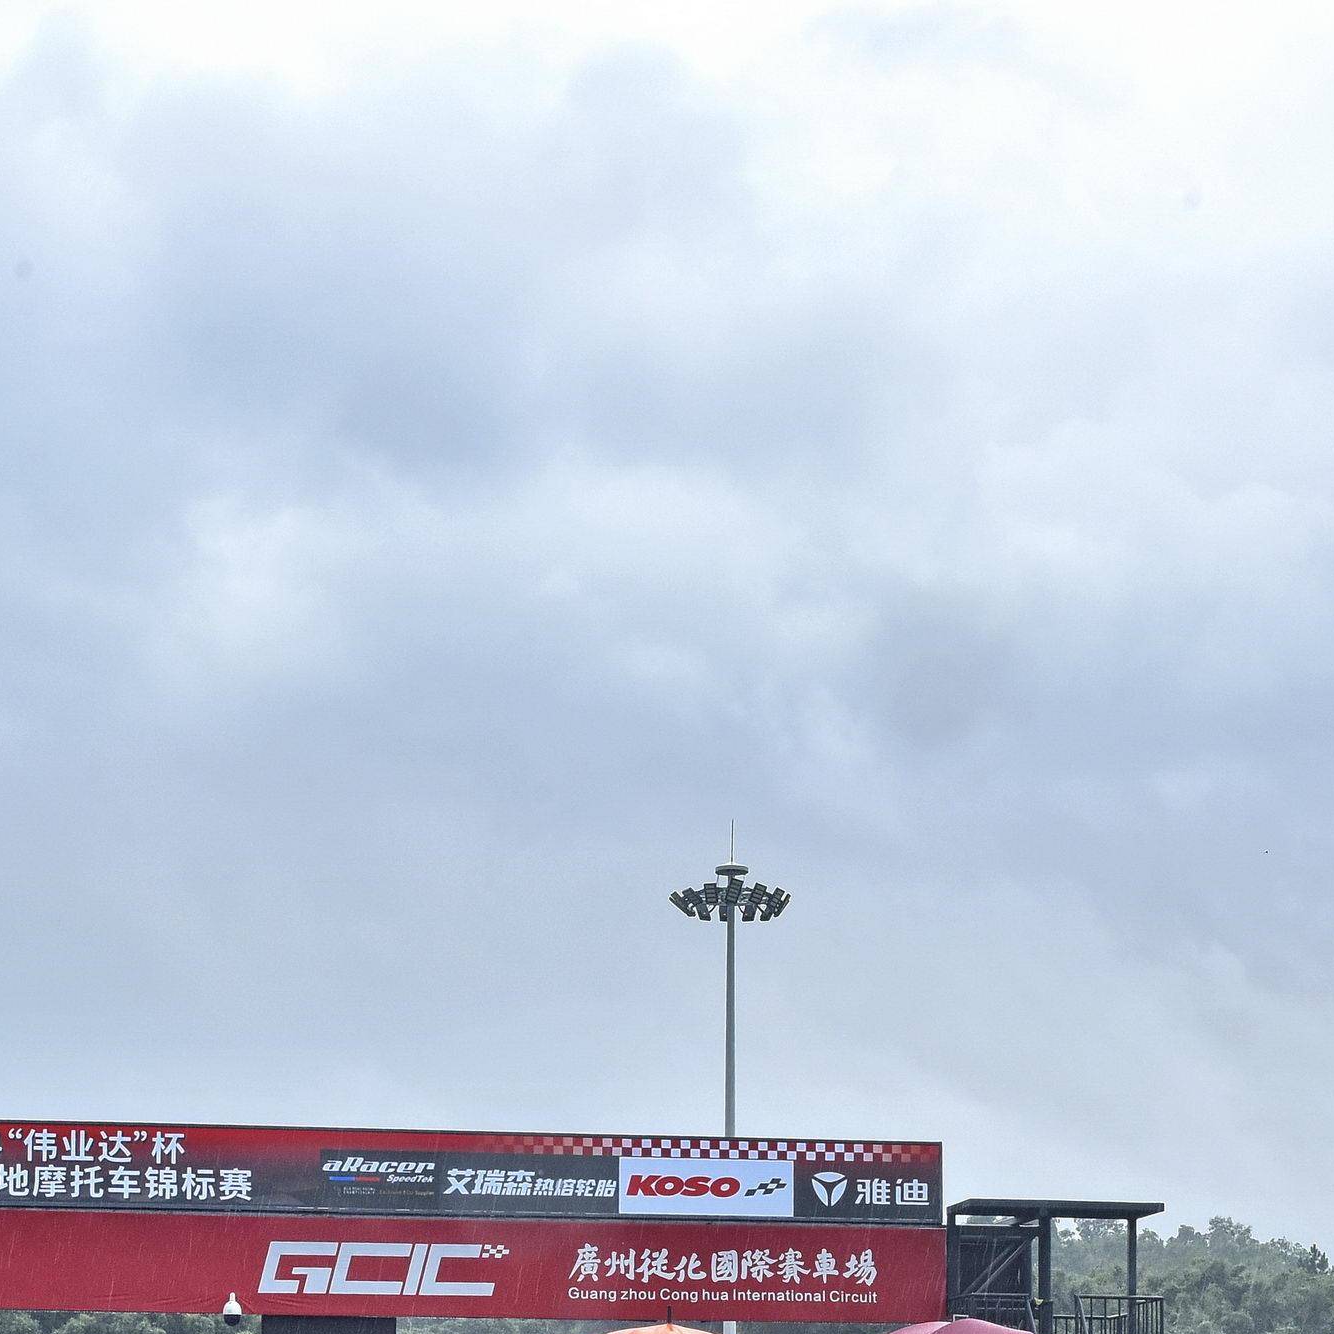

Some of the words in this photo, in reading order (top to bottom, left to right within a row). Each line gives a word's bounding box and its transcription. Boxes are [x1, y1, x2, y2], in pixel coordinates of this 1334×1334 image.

[323, 1156, 436, 1173] aRacer
[386, 1174, 435, 1184] SpeedTek
[626, 1173, 741, 1200] KOSO
[855, 1178, 930, 1206] 雅迪
[257, 1241, 497, 1296] GCIC
[568, 1287, 617, 1302] Guang
[620, 1287, 656, 1301] zhou
[659, 1288, 698, 1303] Cong
[702, 1288, 729, 1301] hua
[732, 1288, 826, 1302] International
[829, 1290, 878, 1303] Circuit
